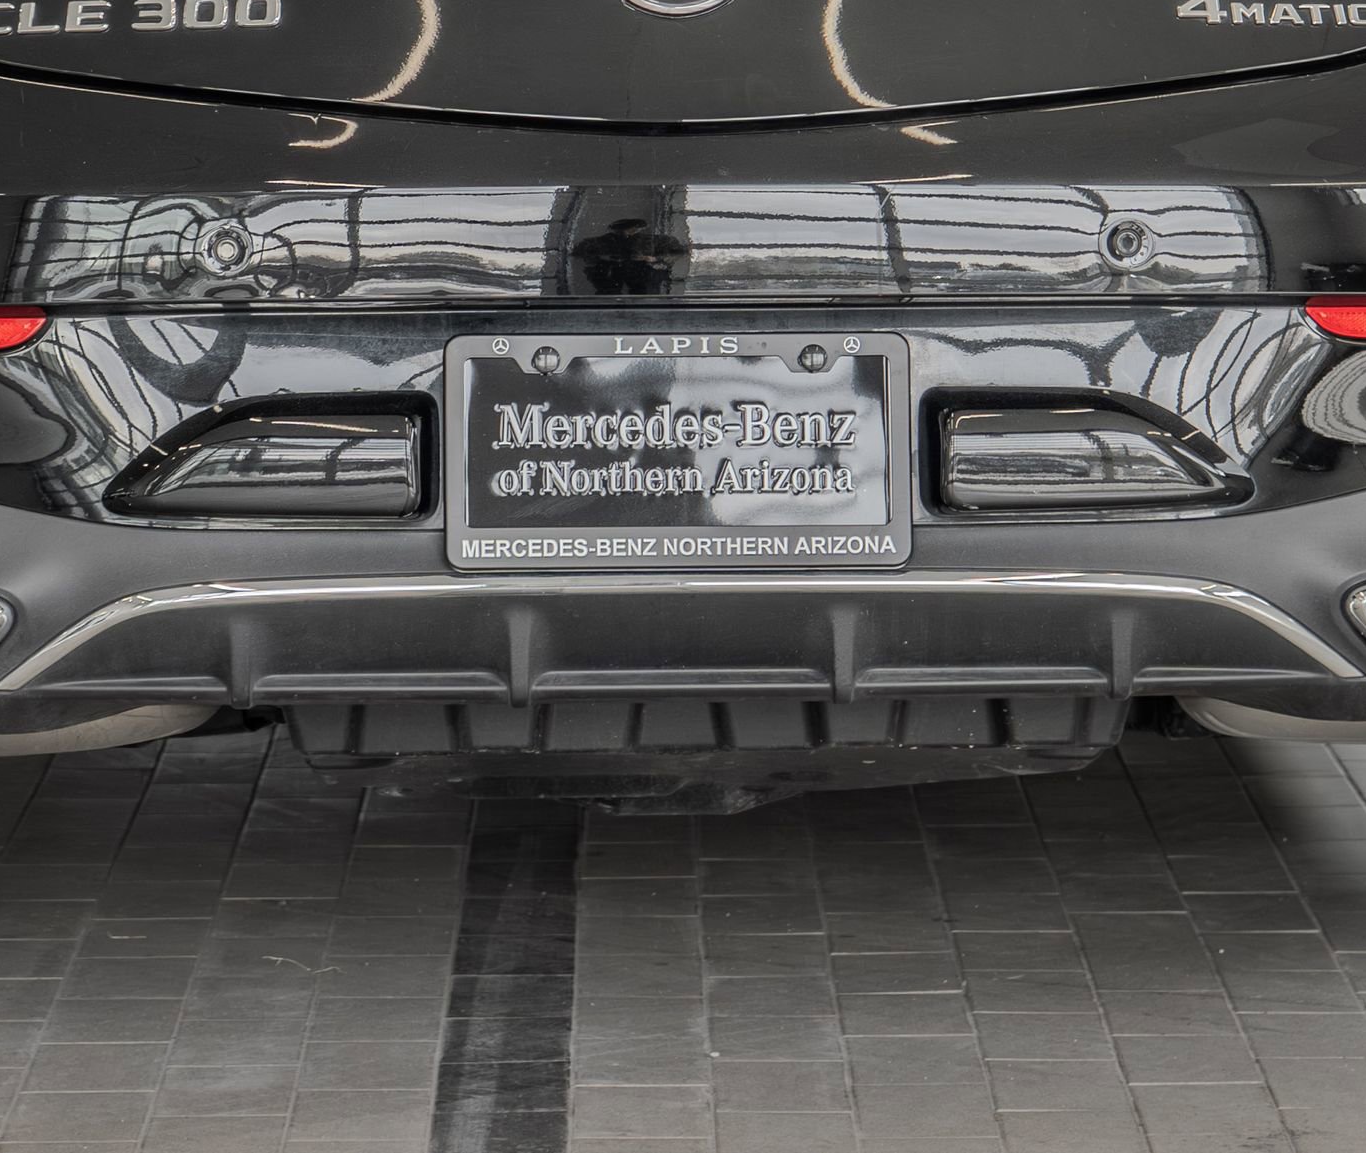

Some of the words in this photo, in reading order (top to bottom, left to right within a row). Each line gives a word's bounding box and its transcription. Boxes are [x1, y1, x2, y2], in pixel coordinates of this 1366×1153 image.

[614, 336, 740, 355] LAPIS
[495, 401, 857, 448] Mercedes-Benz
[498, 460, 536, 496] of
[539, 459, 704, 496] Northern
[713, 457, 854, 494] Arizona
[461, 539, 658, 559] MERCEDES-BENZ
[663, 537, 788, 556] NORTHERN
[794, 535, 897, 555] ARIZONA
